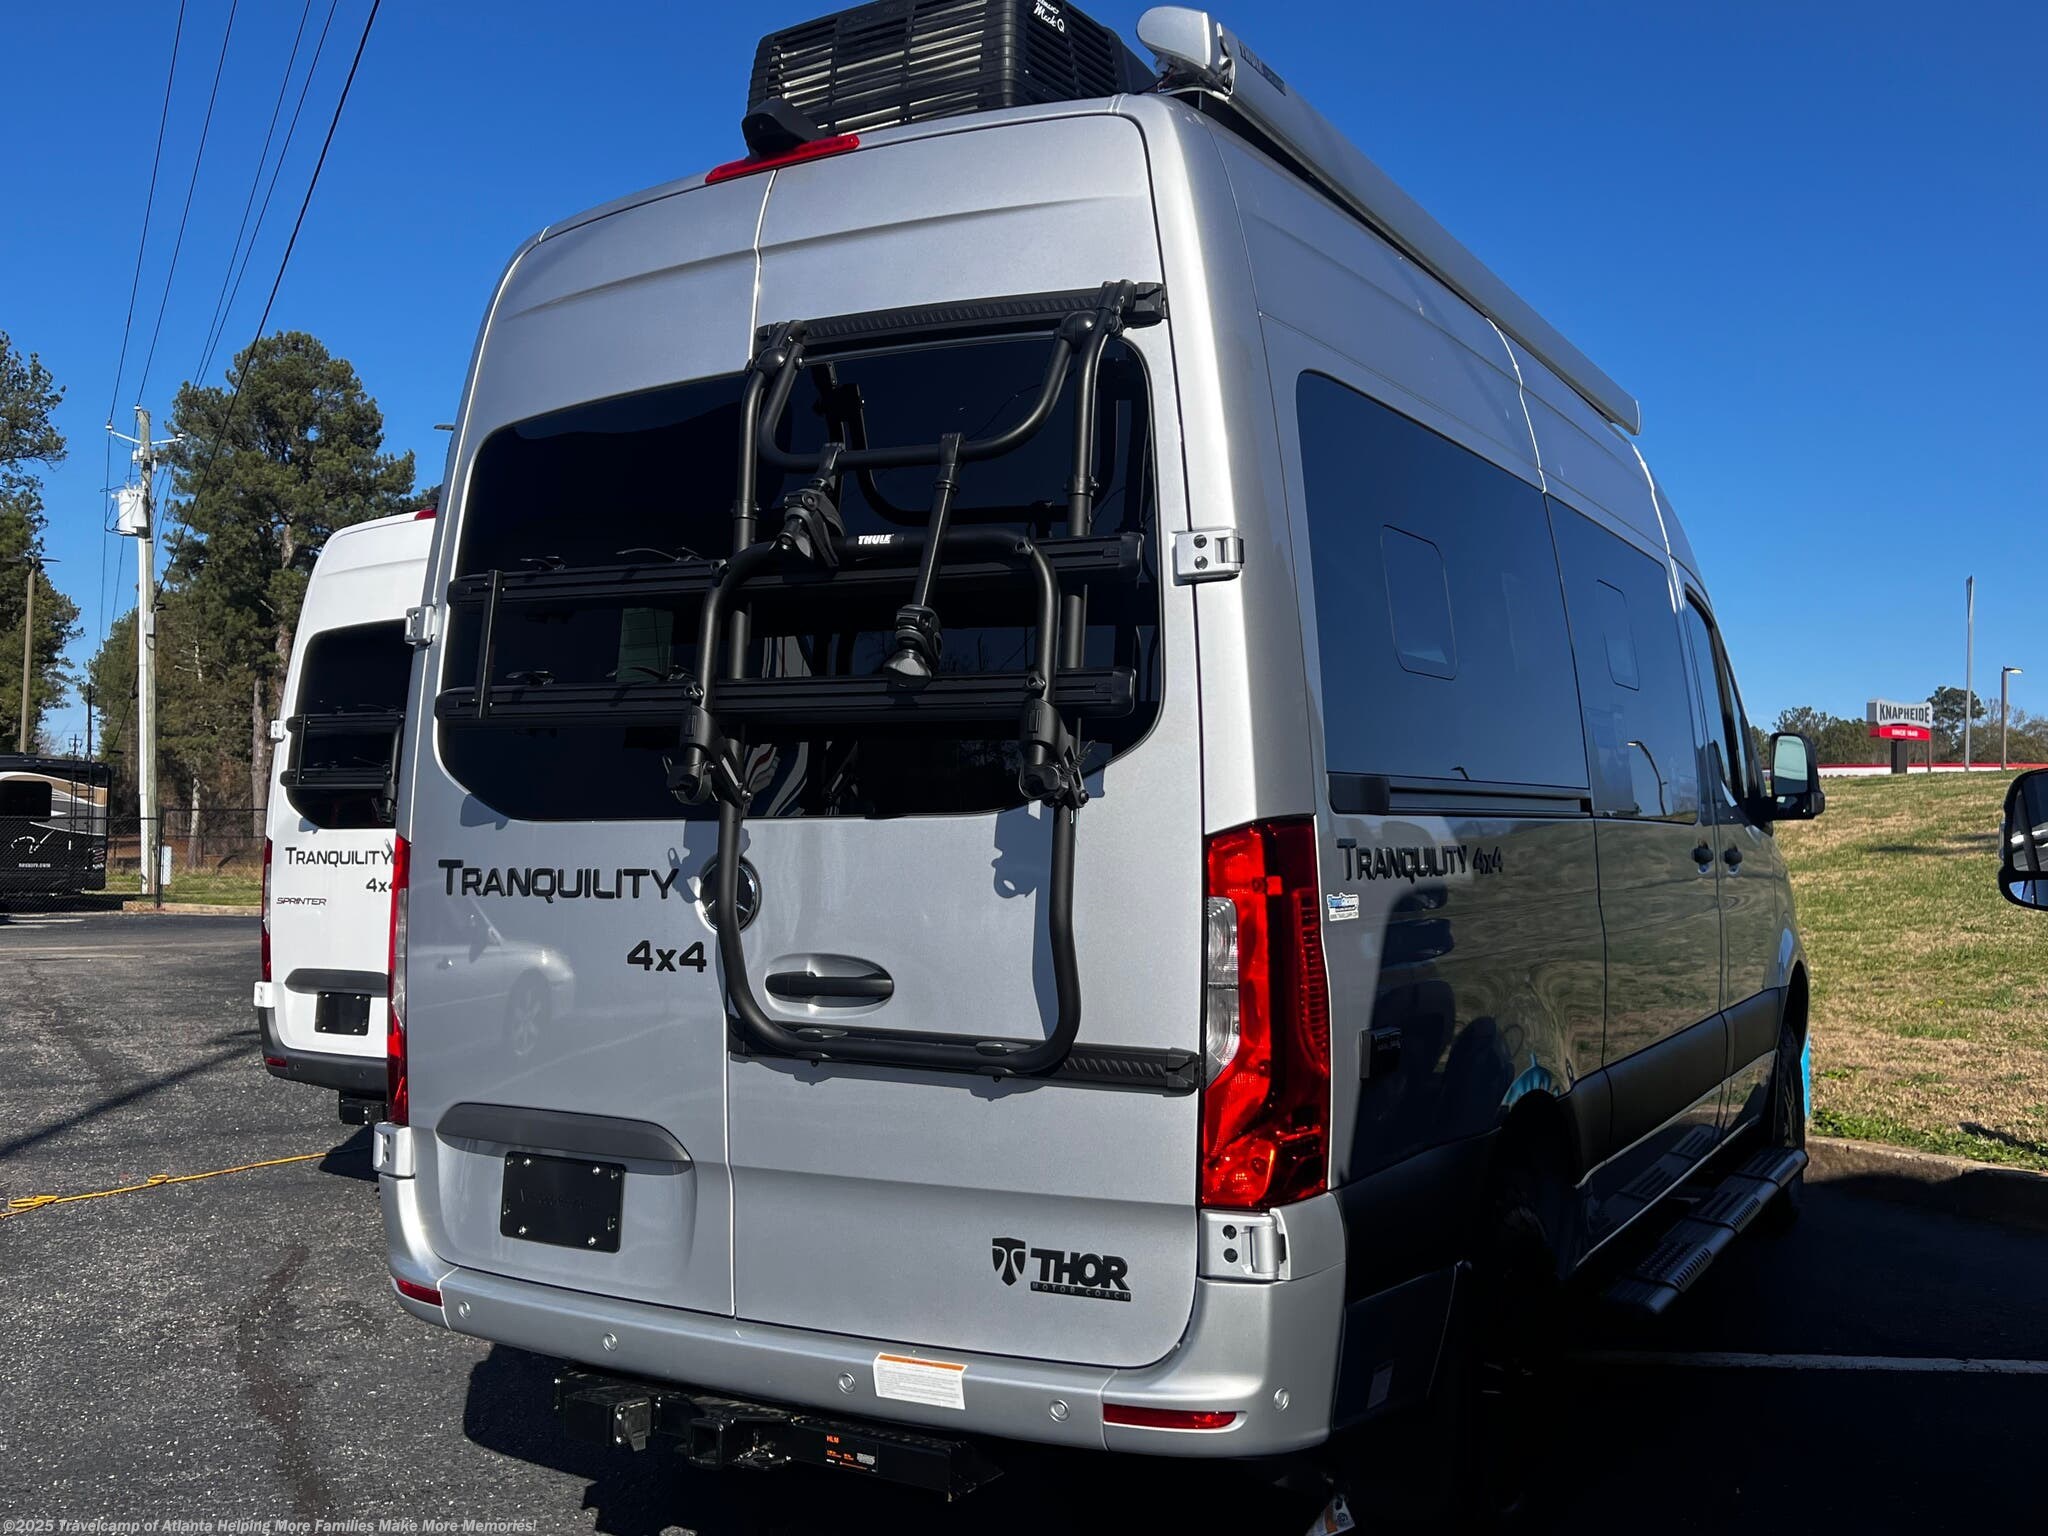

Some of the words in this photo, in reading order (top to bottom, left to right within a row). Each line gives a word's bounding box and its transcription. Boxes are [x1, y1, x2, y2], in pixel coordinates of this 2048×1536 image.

[858, 534, 892, 545] THULE
[1880, 703, 1930, 724] KNAPHEIDE
[285, 847, 393, 867] TRANQUILITY
[1336, 838, 1467, 884] TRANQUILITY
[1472, 846, 1504, 874] 4x4
[438, 859, 679, 903] TRANQUILITY
[276, 897, 327, 906] SPRINTER
[627, 940, 707, 973] 4x4
[1030, 1248, 1130, 1290] THOR
[1032, 1282, 1077, 1294] MOTOR
[1085, 1289, 1131, 1301] COACH
